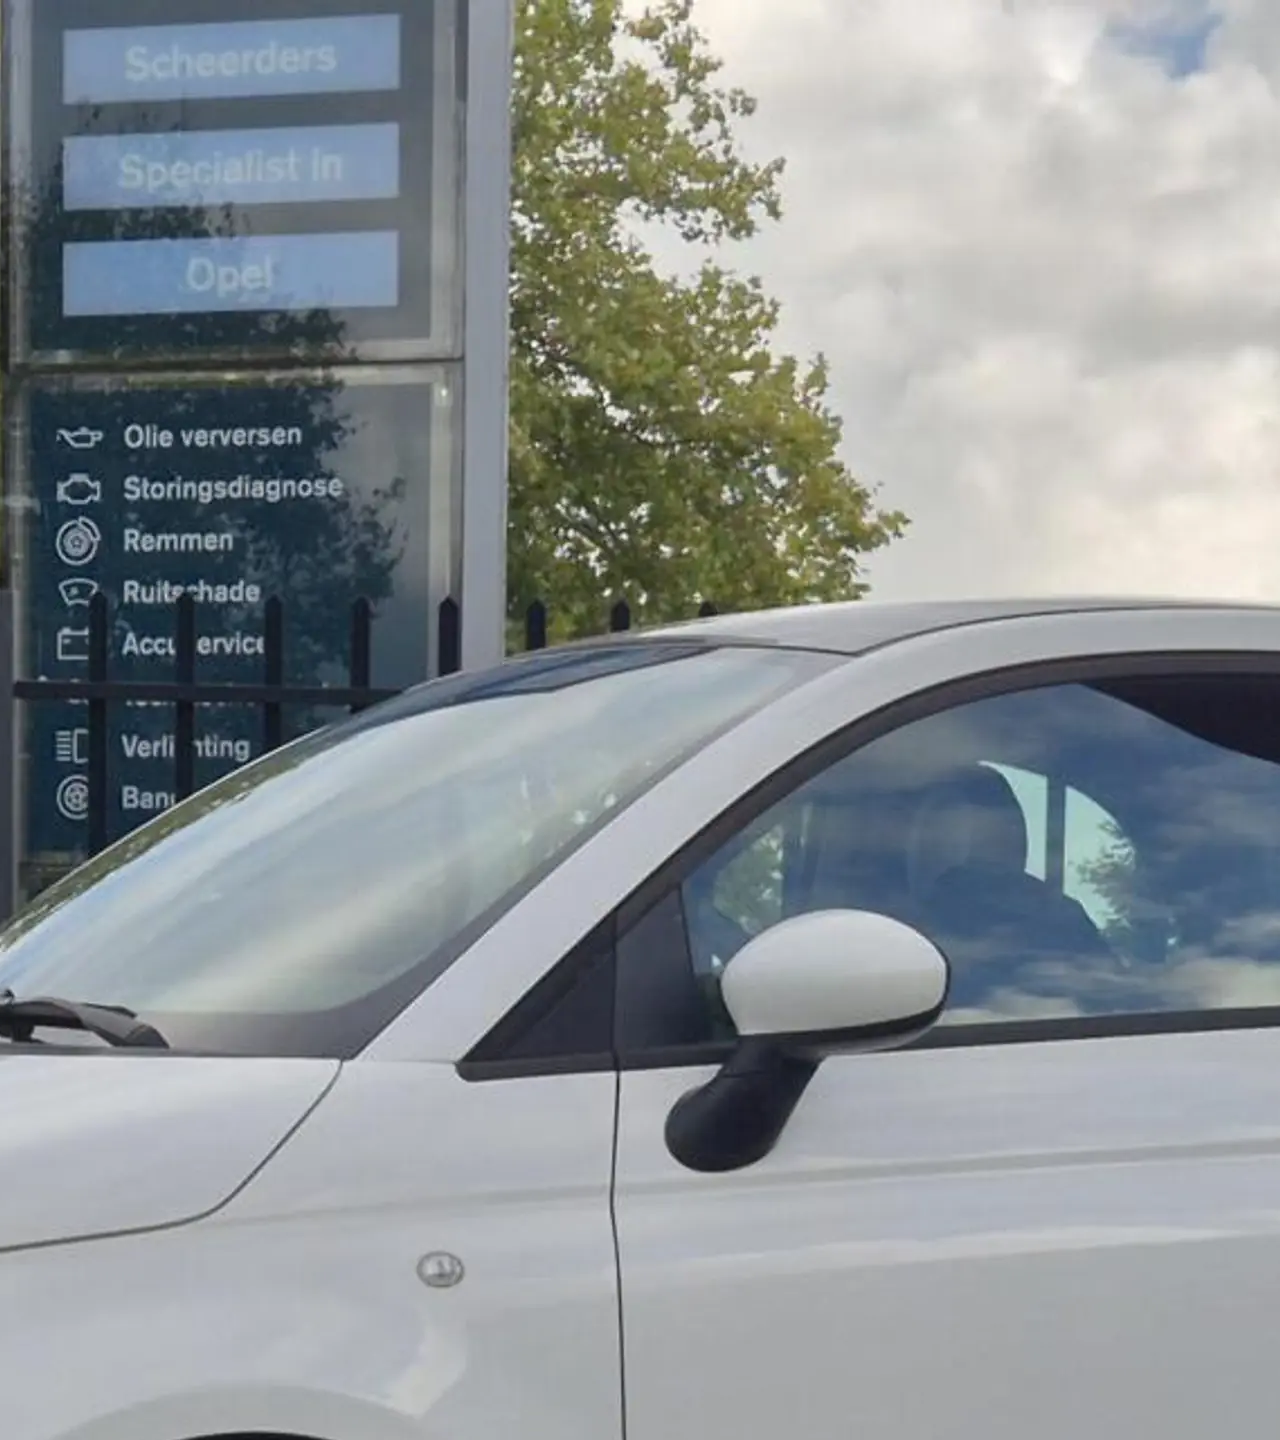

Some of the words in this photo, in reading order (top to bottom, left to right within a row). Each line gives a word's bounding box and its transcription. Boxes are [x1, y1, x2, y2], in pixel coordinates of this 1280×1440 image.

[124, 41, 337, 82] Scheerders
[120, 148, 299, 191] Specialist
[185, 256, 276, 297] Opel
[123, 423, 174, 448] Olie
[180, 426, 303, 448] verversen
[123, 474, 344, 504] Storingsdiagnose
[123, 528, 234, 552] Remmen
[121, 733, 251, 763] Verliting
